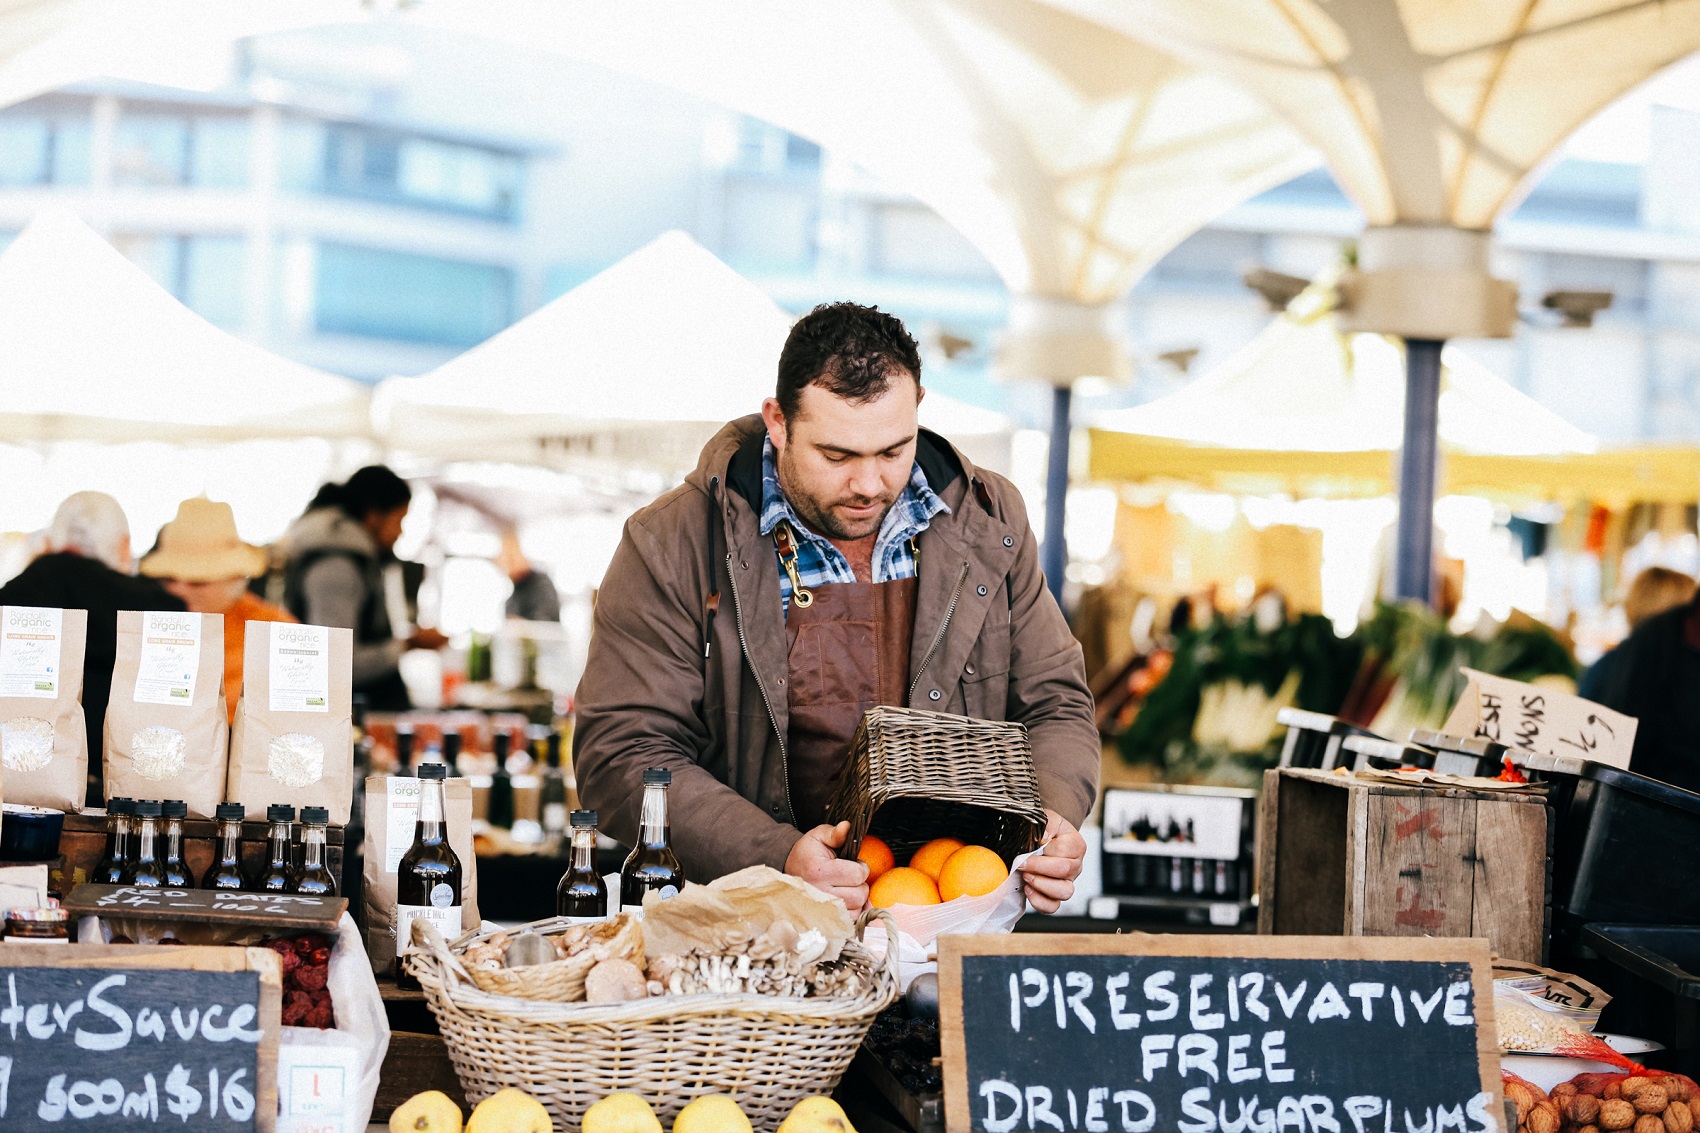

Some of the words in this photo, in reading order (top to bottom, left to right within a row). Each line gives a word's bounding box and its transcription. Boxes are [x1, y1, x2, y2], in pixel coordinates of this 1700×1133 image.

[9, 618, 52, 628] organic
[150, 622, 191, 632] organic
[278, 633, 320, 643] organic
[116, 887, 189, 898] RED
[432, 909, 447, 920] HILL
[1008, 967, 1476, 1034] PRESERVATIVE
[1139, 1030, 1296, 1083] FREE
[979, 1079, 1156, 1133] DRIED
